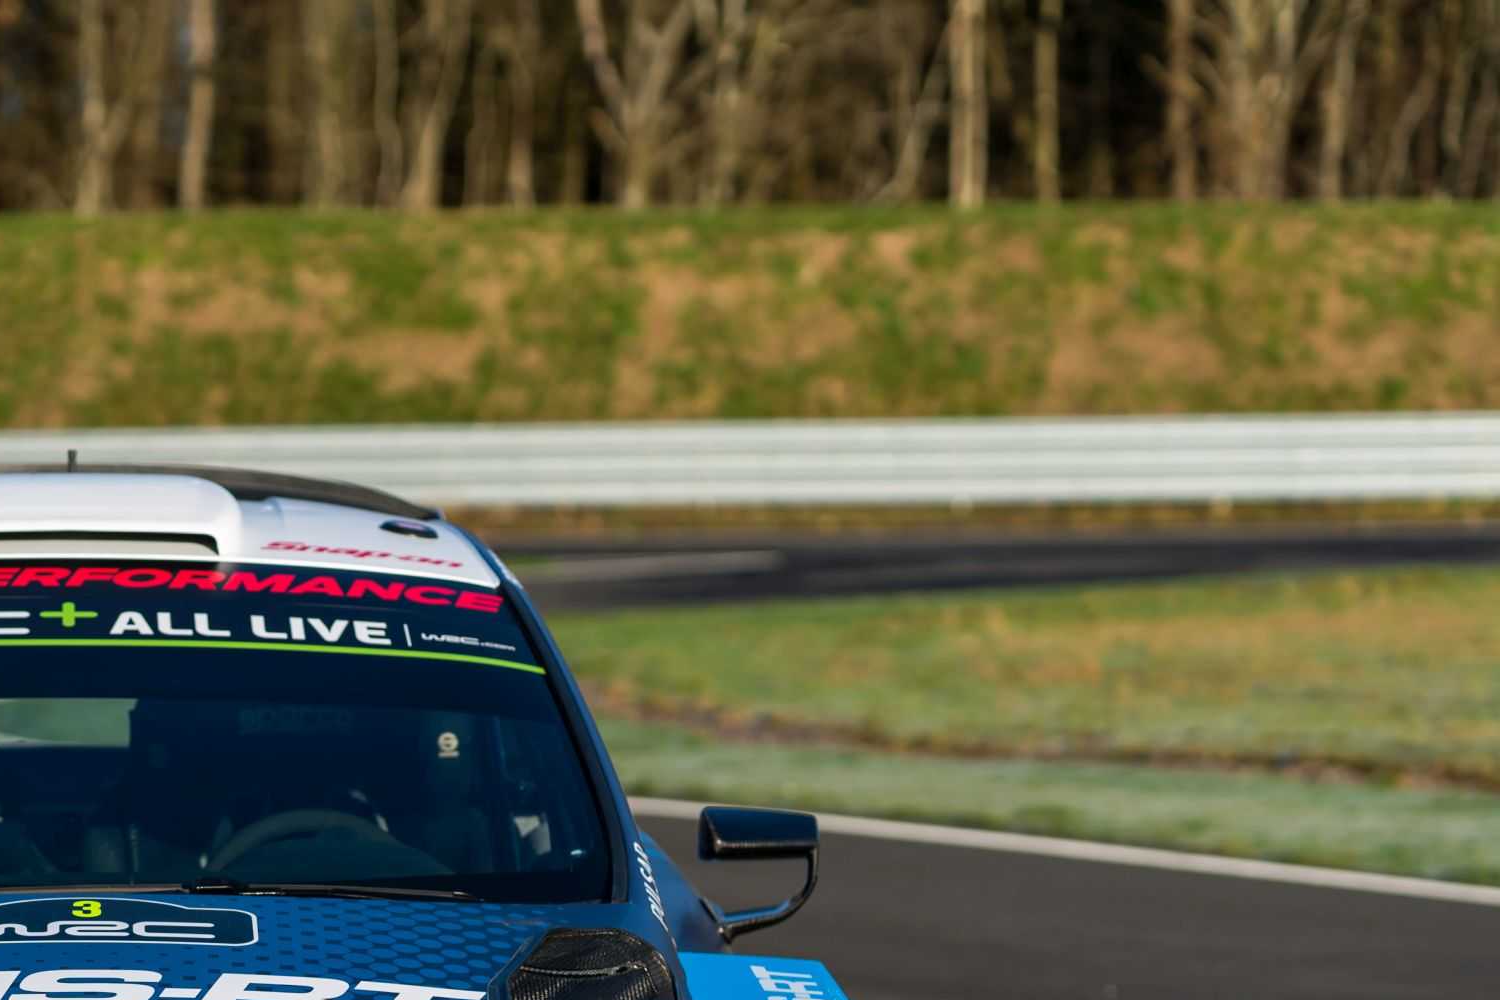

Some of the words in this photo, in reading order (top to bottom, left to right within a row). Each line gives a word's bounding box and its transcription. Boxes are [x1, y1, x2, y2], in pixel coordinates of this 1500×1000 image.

[110, 611, 232, 637] ALL
[250, 614, 393, 645] LIVE
[71, 900, 103, 918] 3
